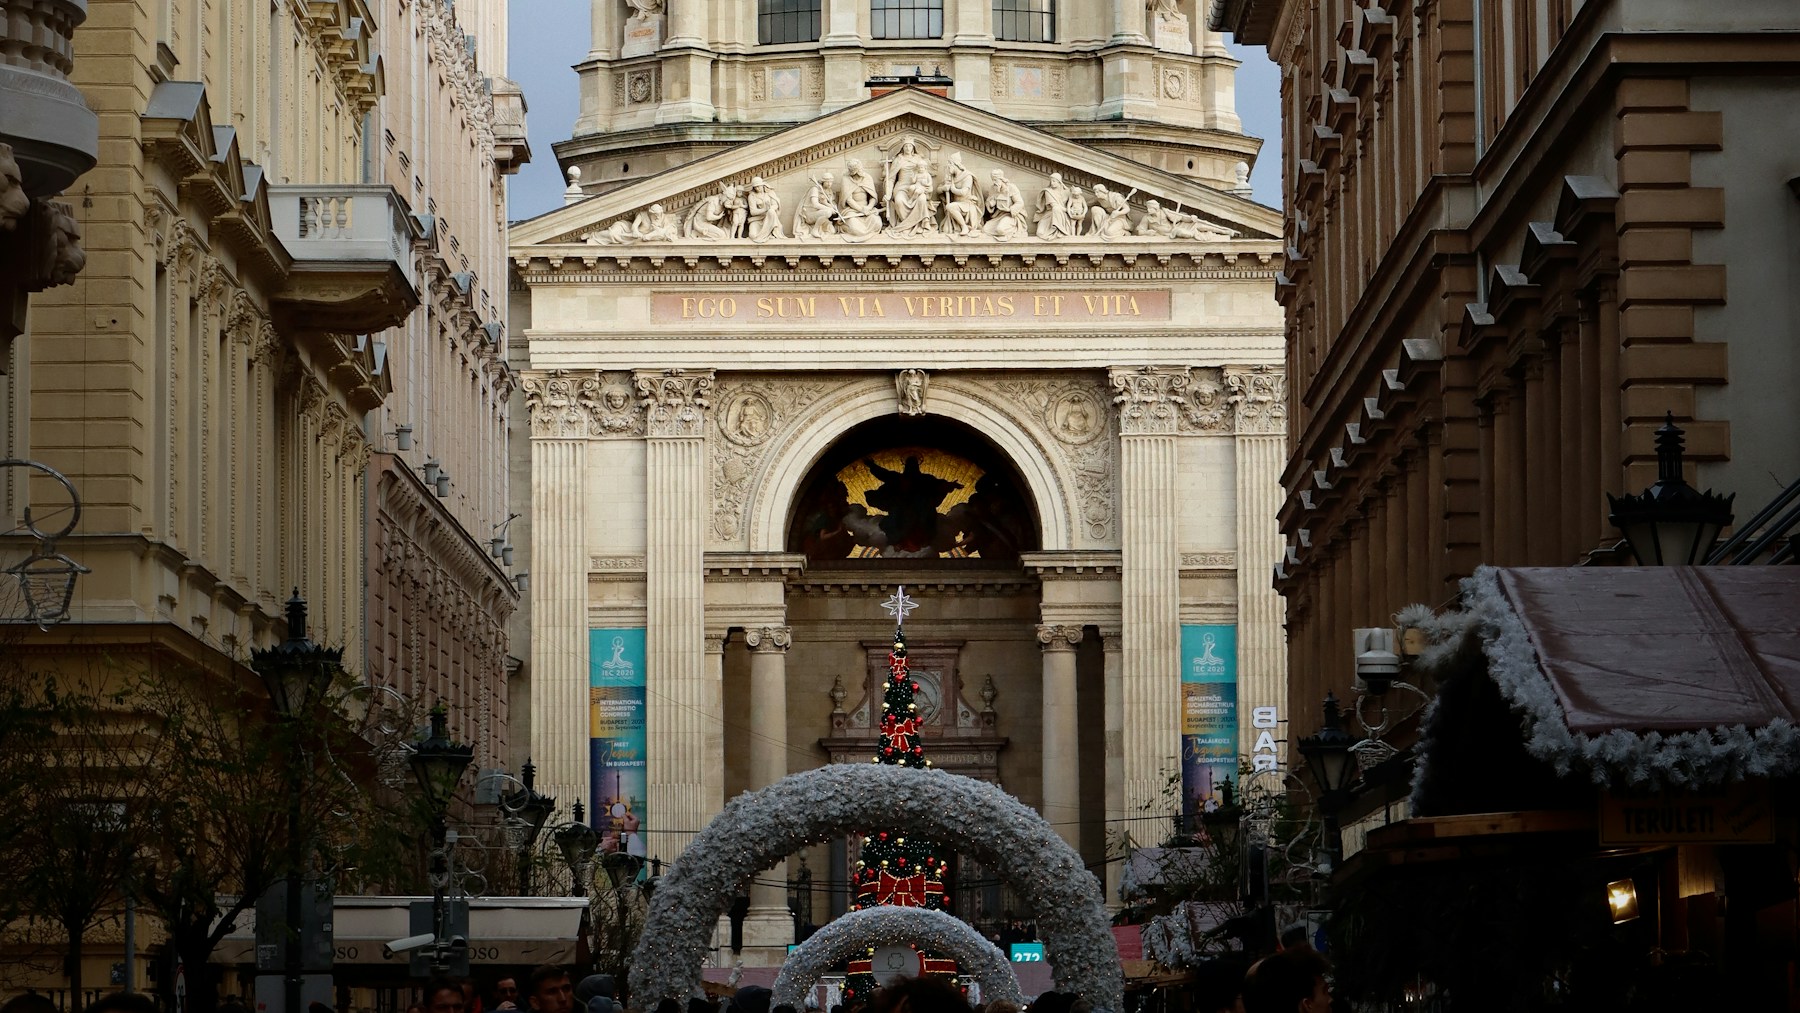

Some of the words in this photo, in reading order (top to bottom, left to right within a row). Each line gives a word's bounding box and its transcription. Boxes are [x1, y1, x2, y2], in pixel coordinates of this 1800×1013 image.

[681, 297, 737, 318] EGO
[756, 297, 816, 318] SUM
[838, 296, 885, 318] VIA
[903, 295, 1015, 318] VERITAS
[1033, 295, 1065, 317] ET
[1082, 294, 1142, 316] VITA
[1193, 665, 1205, 673] IEC
[1207, 665, 1225, 673] 2020
